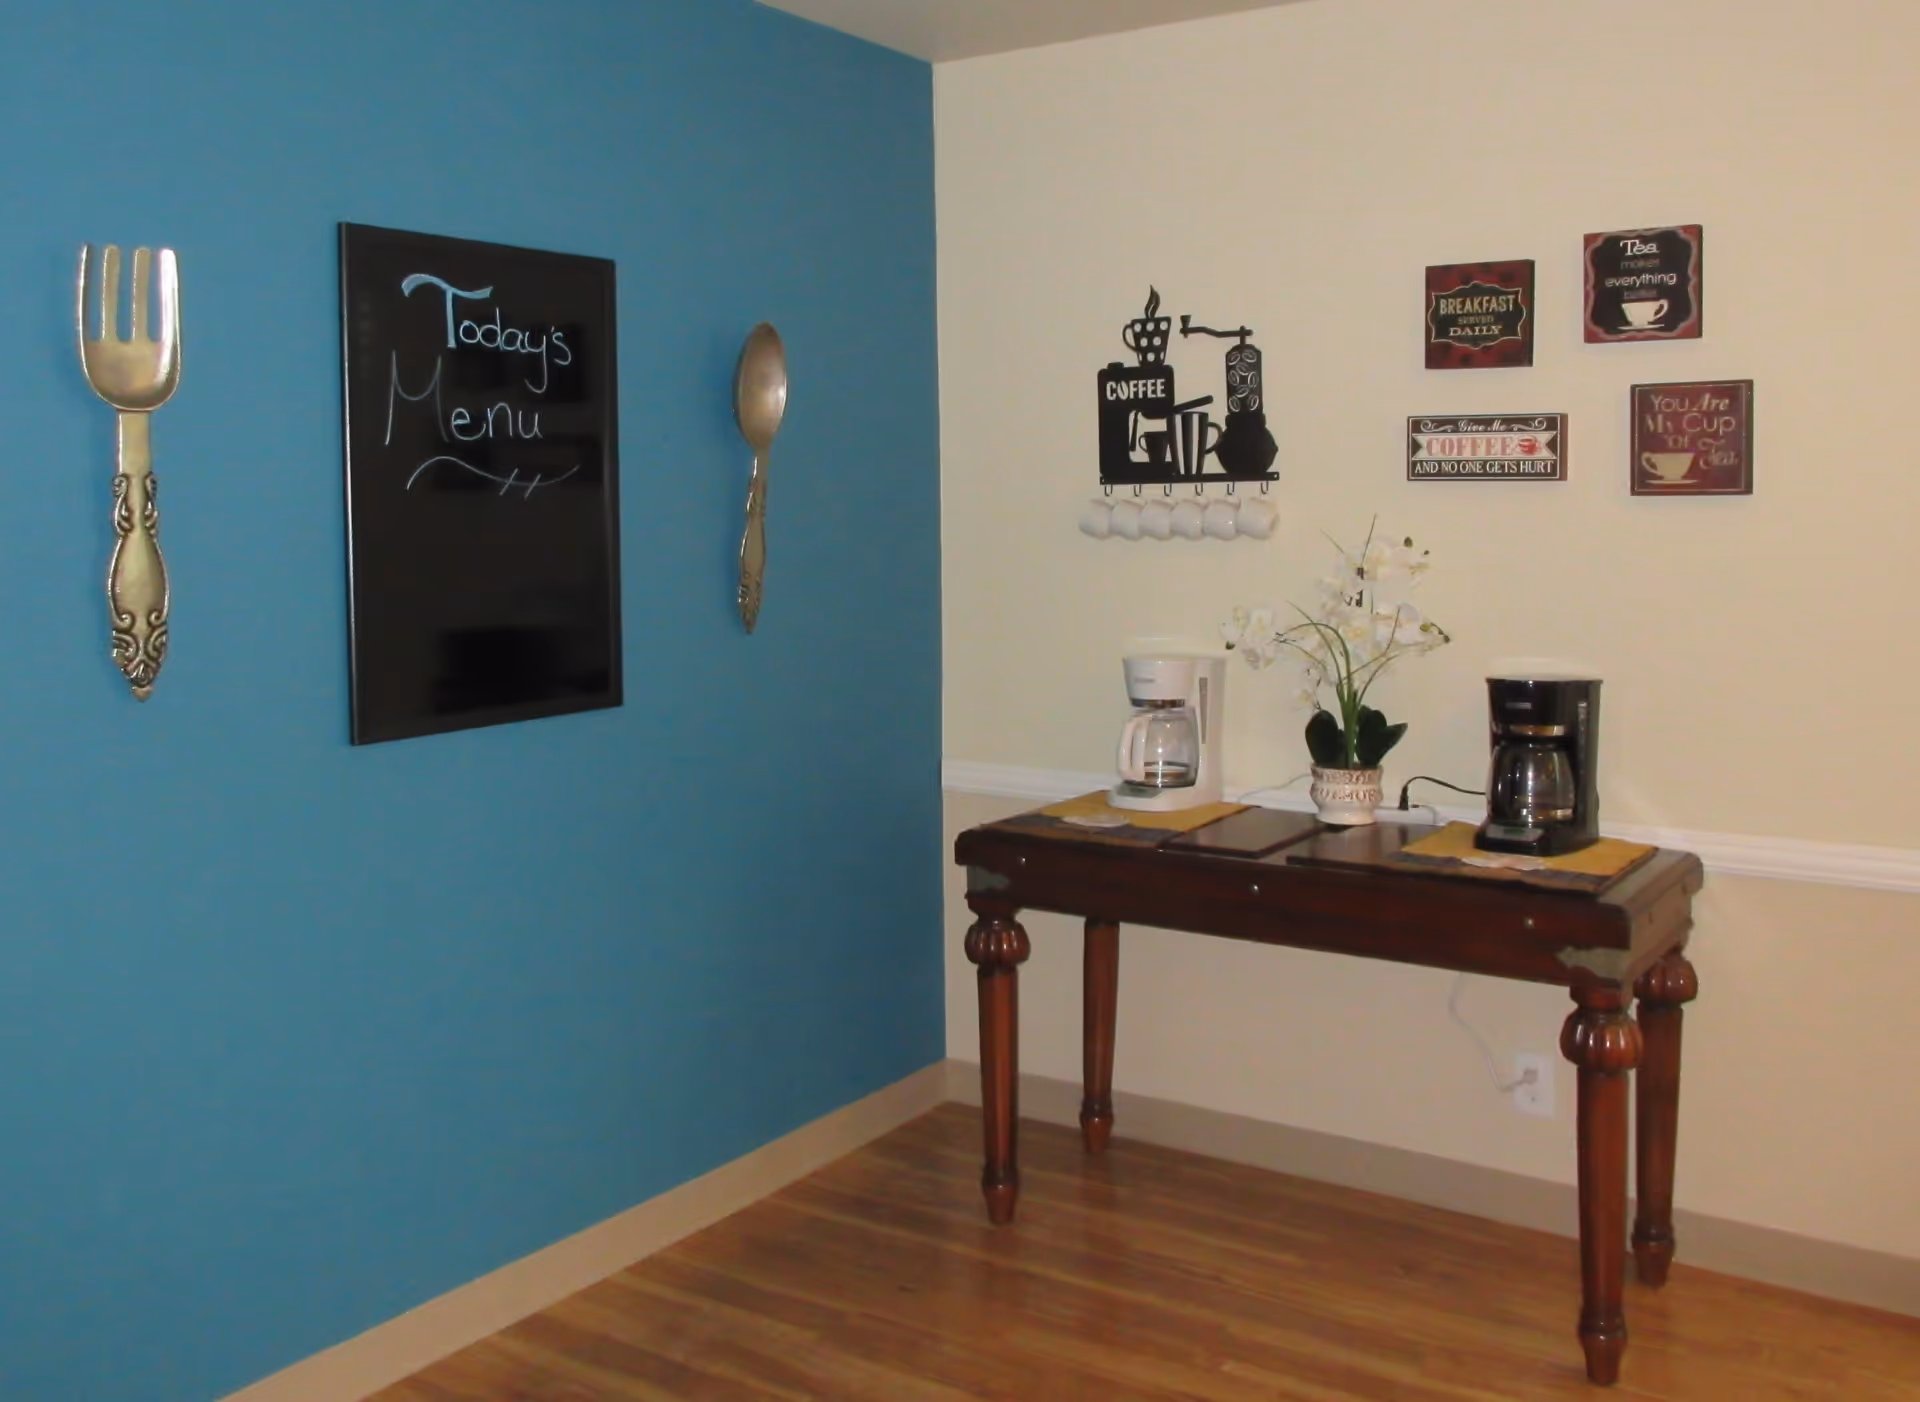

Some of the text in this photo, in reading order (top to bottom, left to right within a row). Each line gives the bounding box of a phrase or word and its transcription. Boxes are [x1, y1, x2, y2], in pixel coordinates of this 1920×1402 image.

[1619, 239, 1660, 256] Tea
[1604, 272, 1677, 288] everything
[1439, 294, 1516, 315] BREAKFAST
[401, 273, 572, 394] Today's
[1448, 325, 1503, 337] DAILY
[384, 350, 543, 446] Menu
[1106, 378, 1166, 401] COFFEE
[1457, 419, 1507, 432] Give Me
[1425, 436, 1514, 457] COFFEE
[1414, 459, 1554, 475] AND NO ONE GETS HURT
